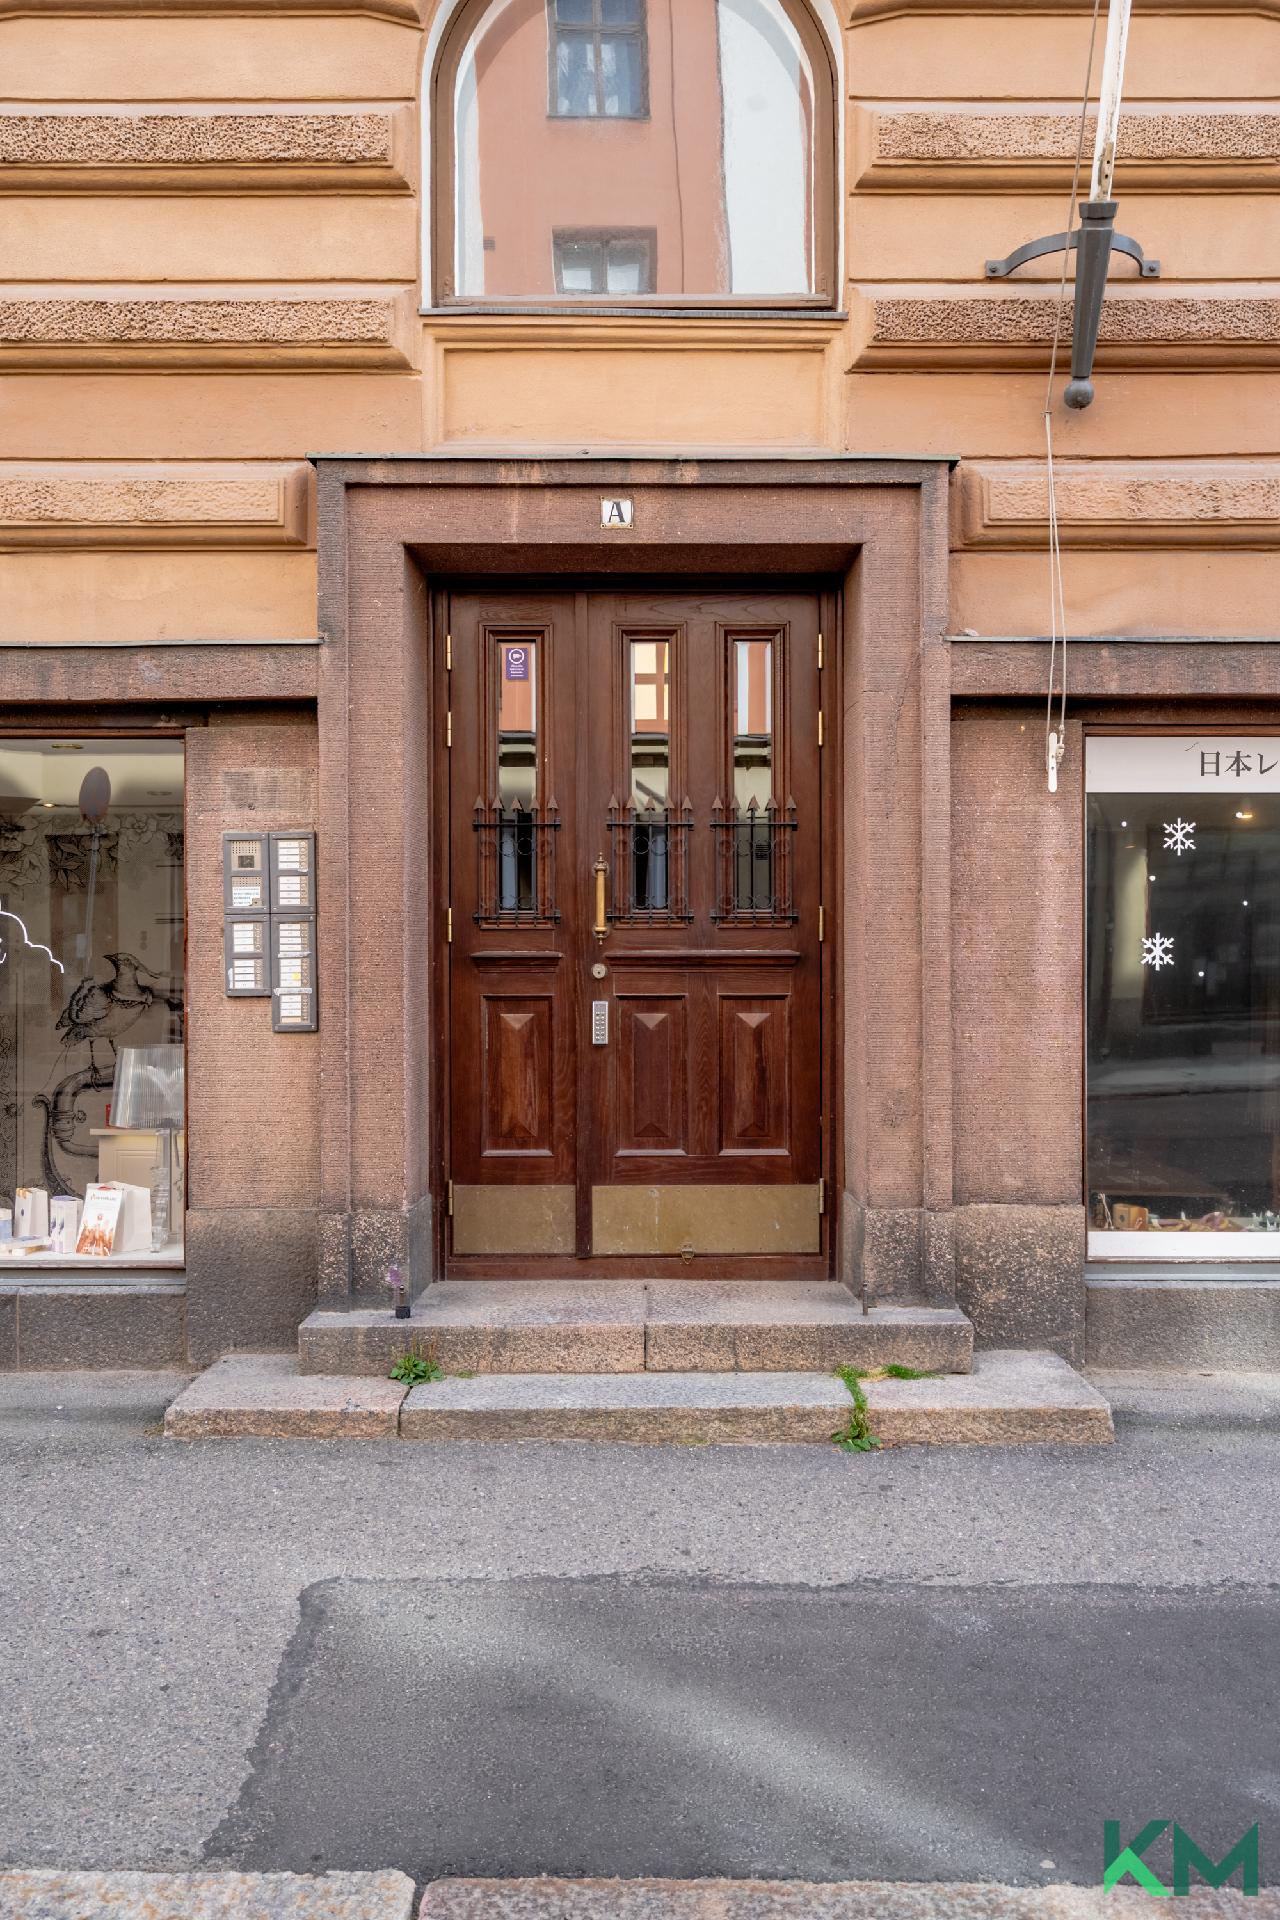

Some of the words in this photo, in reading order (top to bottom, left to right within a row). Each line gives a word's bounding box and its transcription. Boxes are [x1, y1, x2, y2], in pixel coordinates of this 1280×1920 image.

[608, 501, 626, 523] A
[1200, 750, 1279, 777] 日本レ
